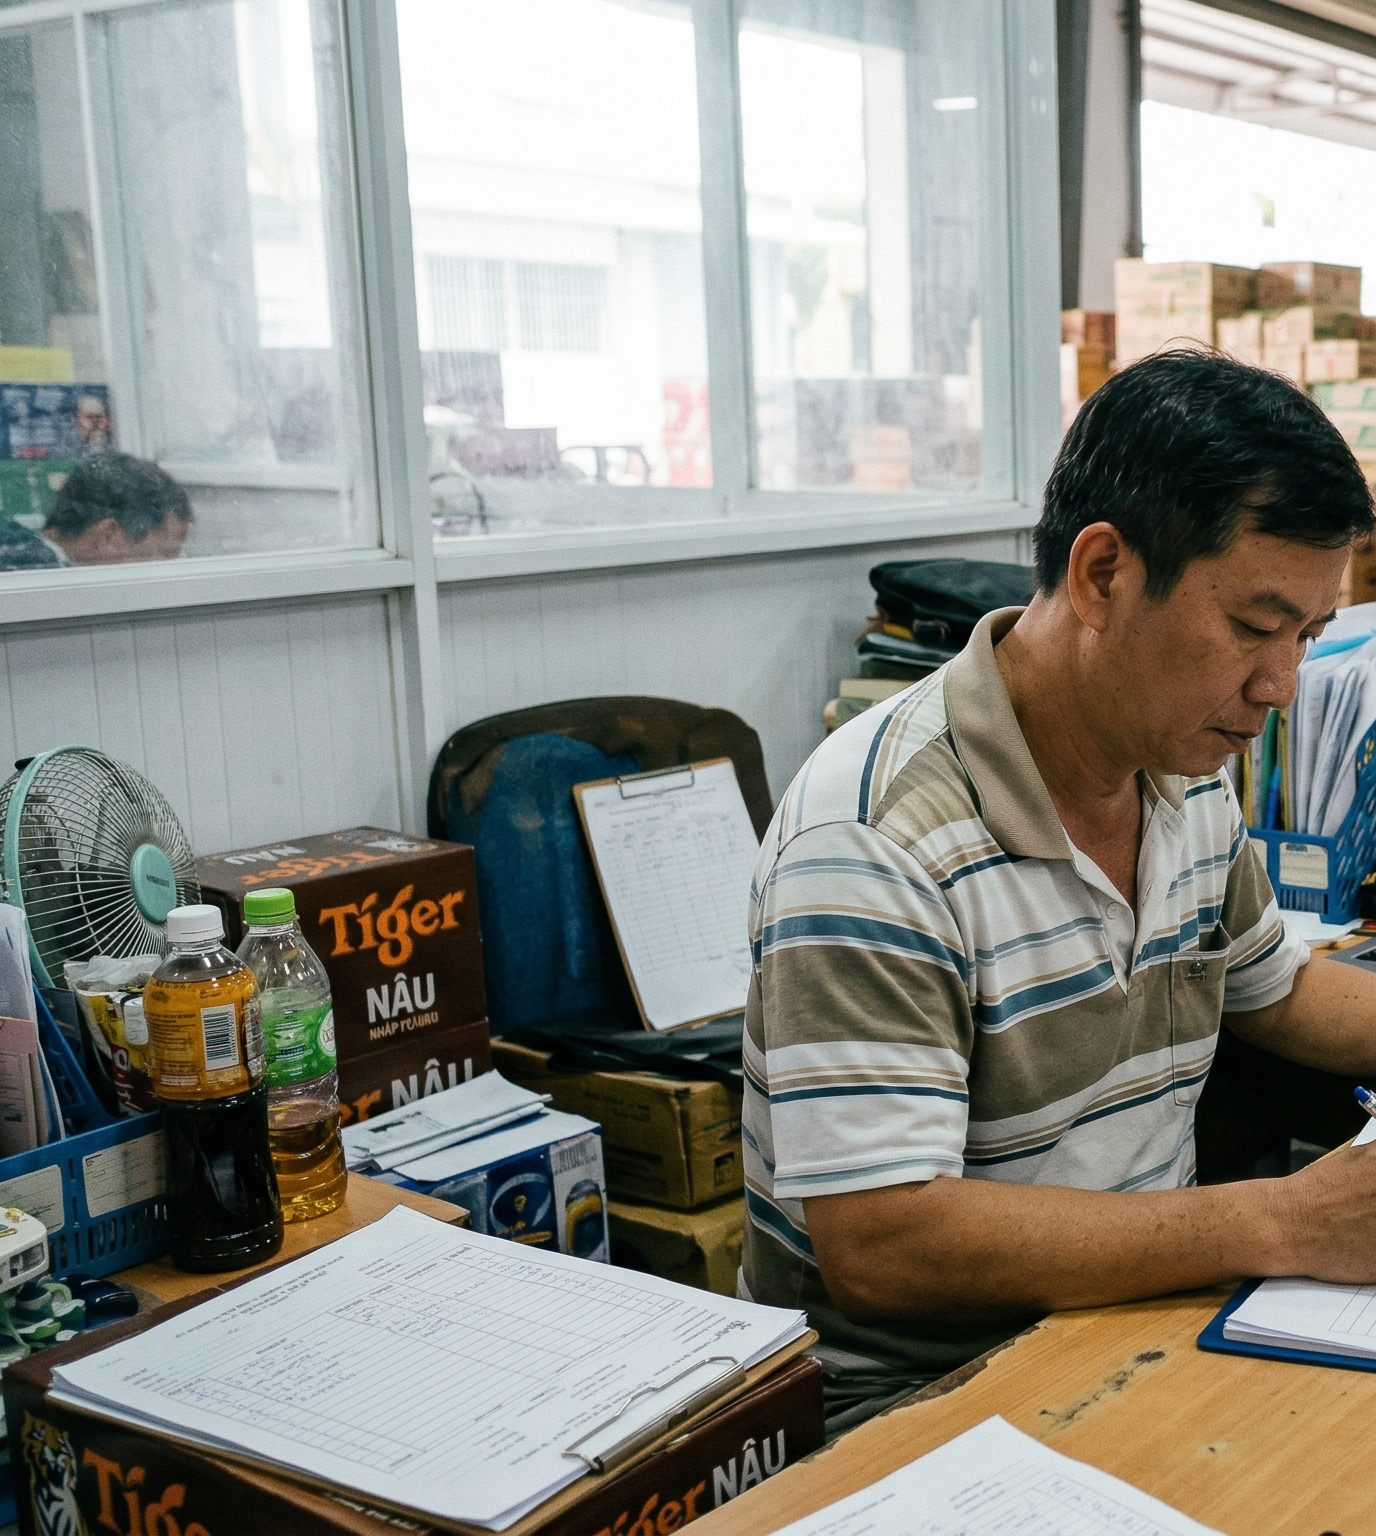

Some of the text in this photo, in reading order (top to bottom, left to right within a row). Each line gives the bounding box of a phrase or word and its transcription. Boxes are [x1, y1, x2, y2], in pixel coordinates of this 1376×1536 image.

[319, 884, 465, 967] Tiger
[367, 973, 436, 1024] NÂU
[712, 1429, 786, 1508] NÂU
